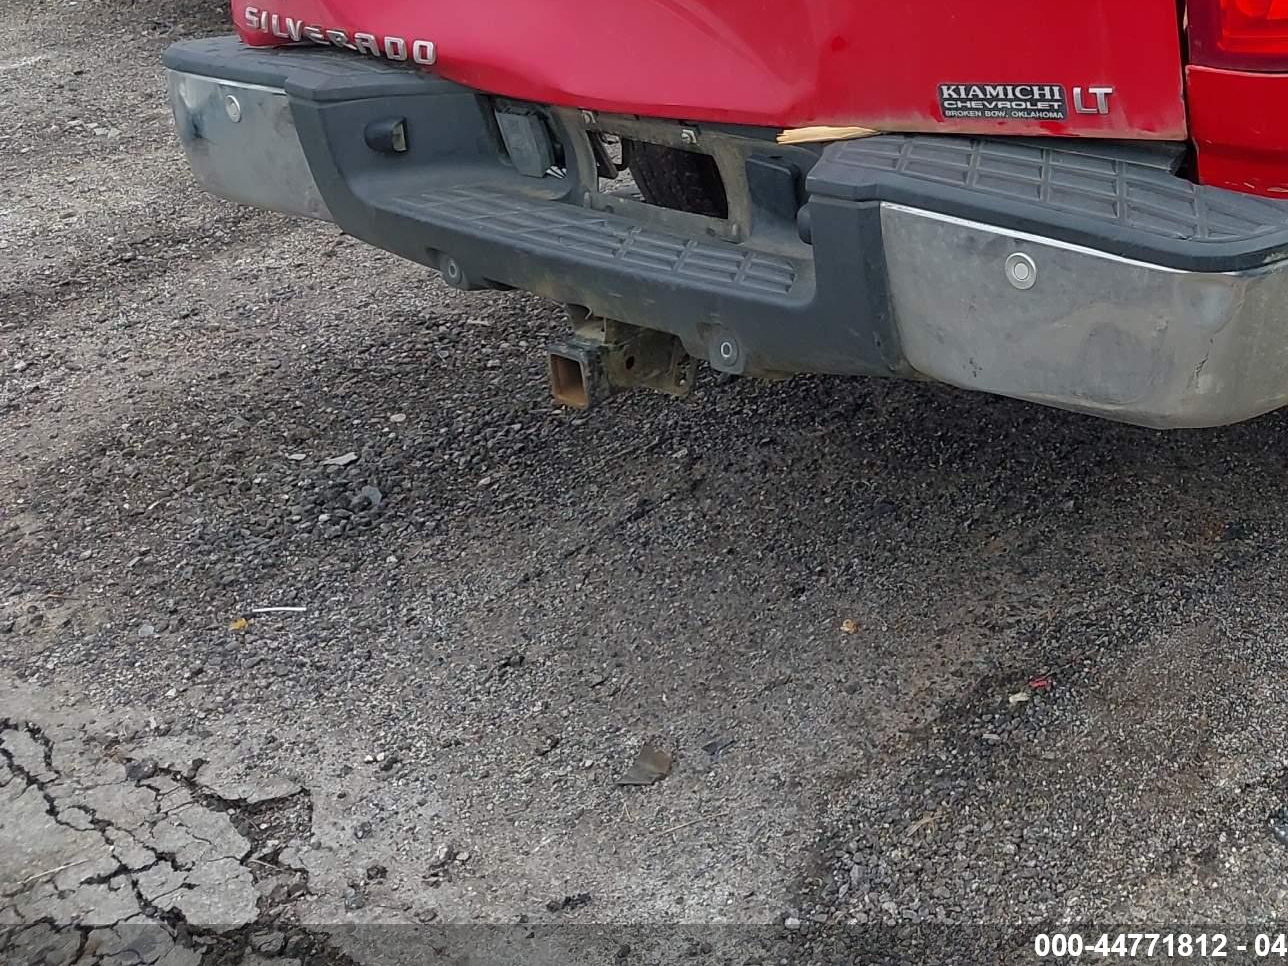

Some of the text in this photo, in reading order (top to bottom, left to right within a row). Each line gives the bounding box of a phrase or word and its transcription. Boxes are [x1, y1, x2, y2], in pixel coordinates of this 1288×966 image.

[245, 6, 436, 65] SILVERADO
[940, 85, 1063, 100] KIAMICHI
[943, 100, 1063, 110] CHEVROLET
[1073, 87, 1113, 114] LT
[945, 110, 982, 118] BROKEN
[1011, 110, 1064, 119] OKLAHOMA
